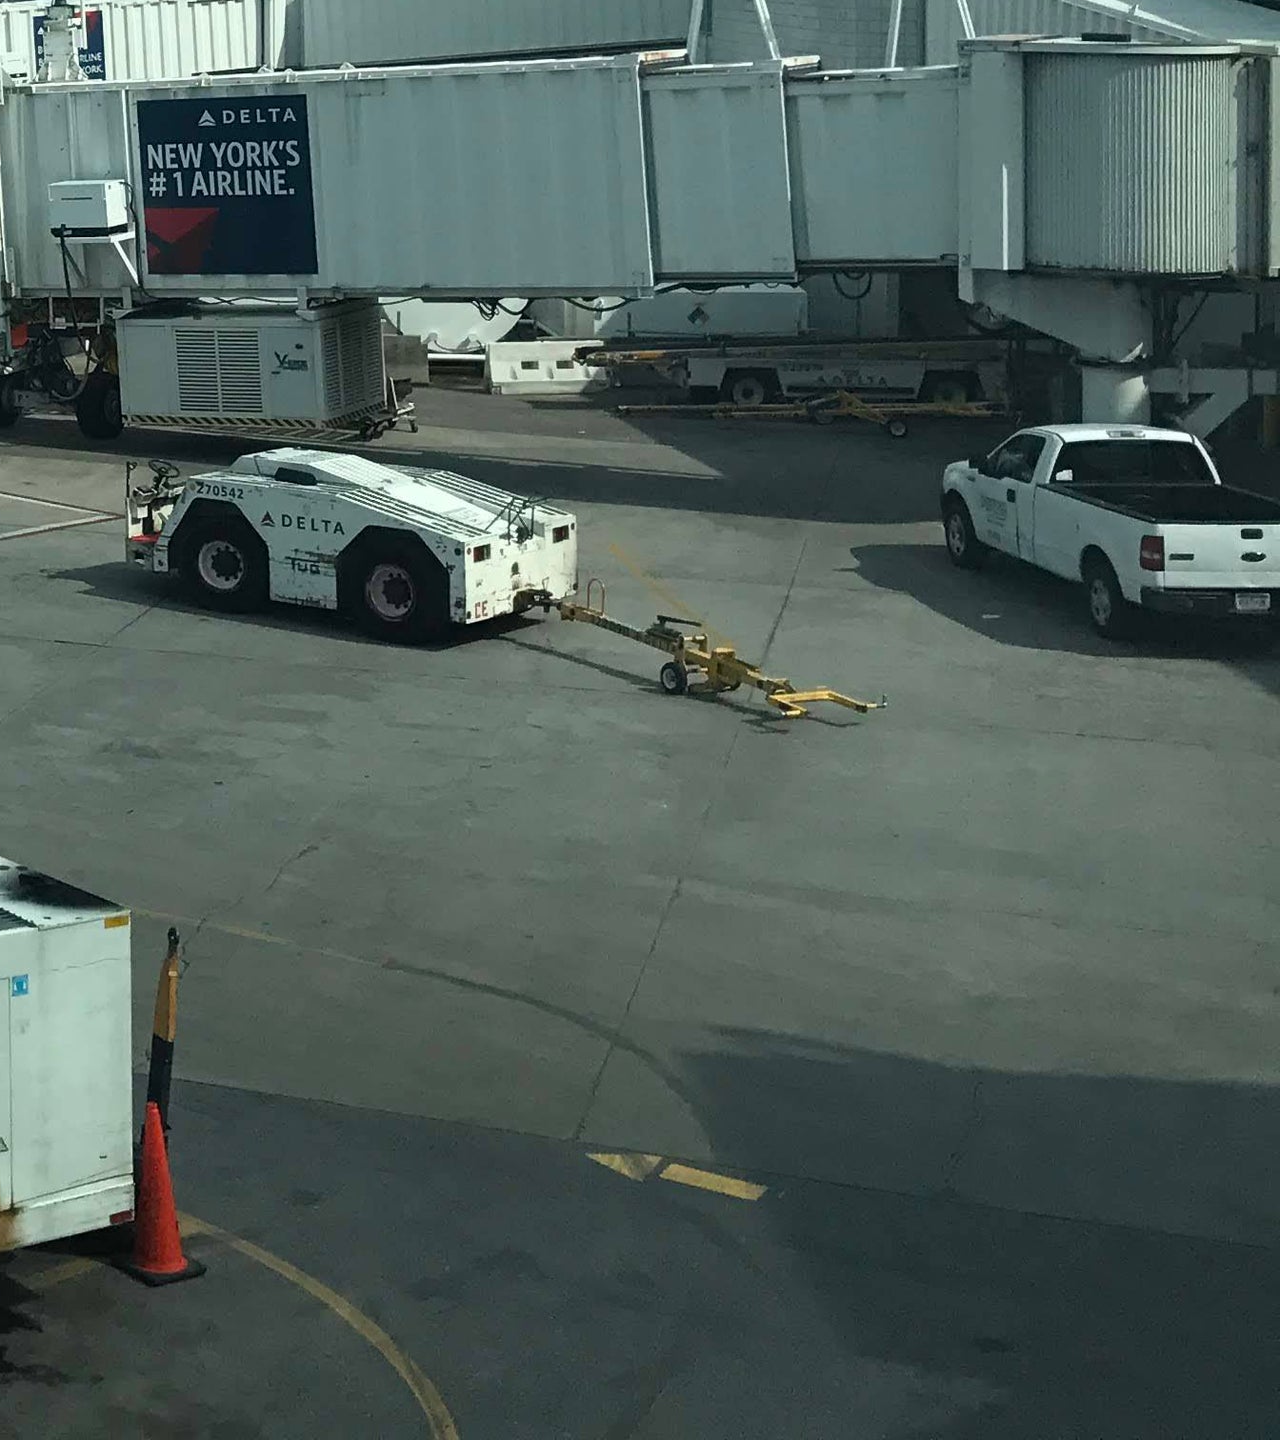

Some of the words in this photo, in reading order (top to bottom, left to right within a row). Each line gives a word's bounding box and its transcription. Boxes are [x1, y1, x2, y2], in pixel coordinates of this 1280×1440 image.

[222, 108, 297, 124] DELTA
[146, 143, 204, 169] NEW
[209, 140, 301, 168] YORK'S
[191, 169, 295, 197] AIRLINE.
[196, 482, 244, 499] 270542
[281, 513, 345, 535] DELTA
[475, 600, 488, 618] CE
